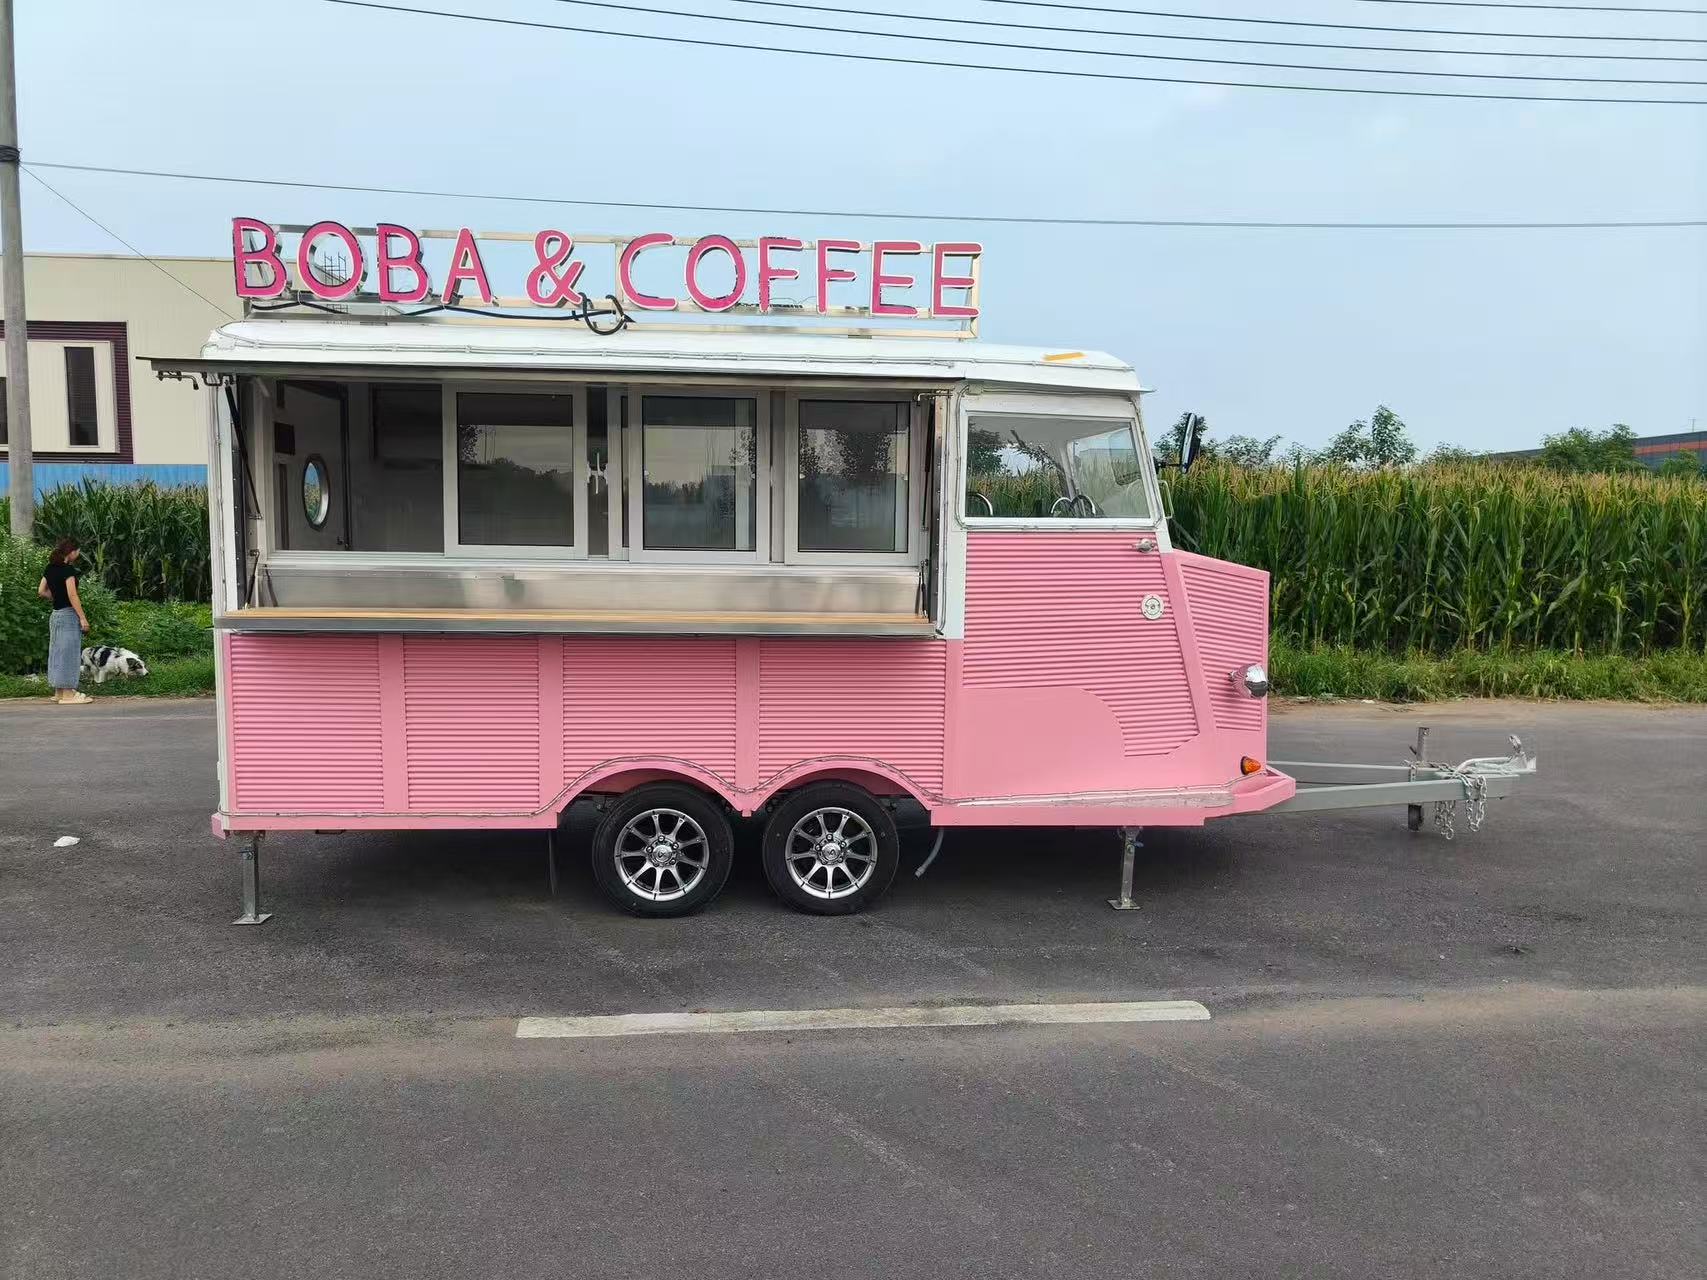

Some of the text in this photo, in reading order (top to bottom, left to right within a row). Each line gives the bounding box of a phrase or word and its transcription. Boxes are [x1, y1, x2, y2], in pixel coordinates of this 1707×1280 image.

[232, 217, 983, 318] BOBA & COFFEE
